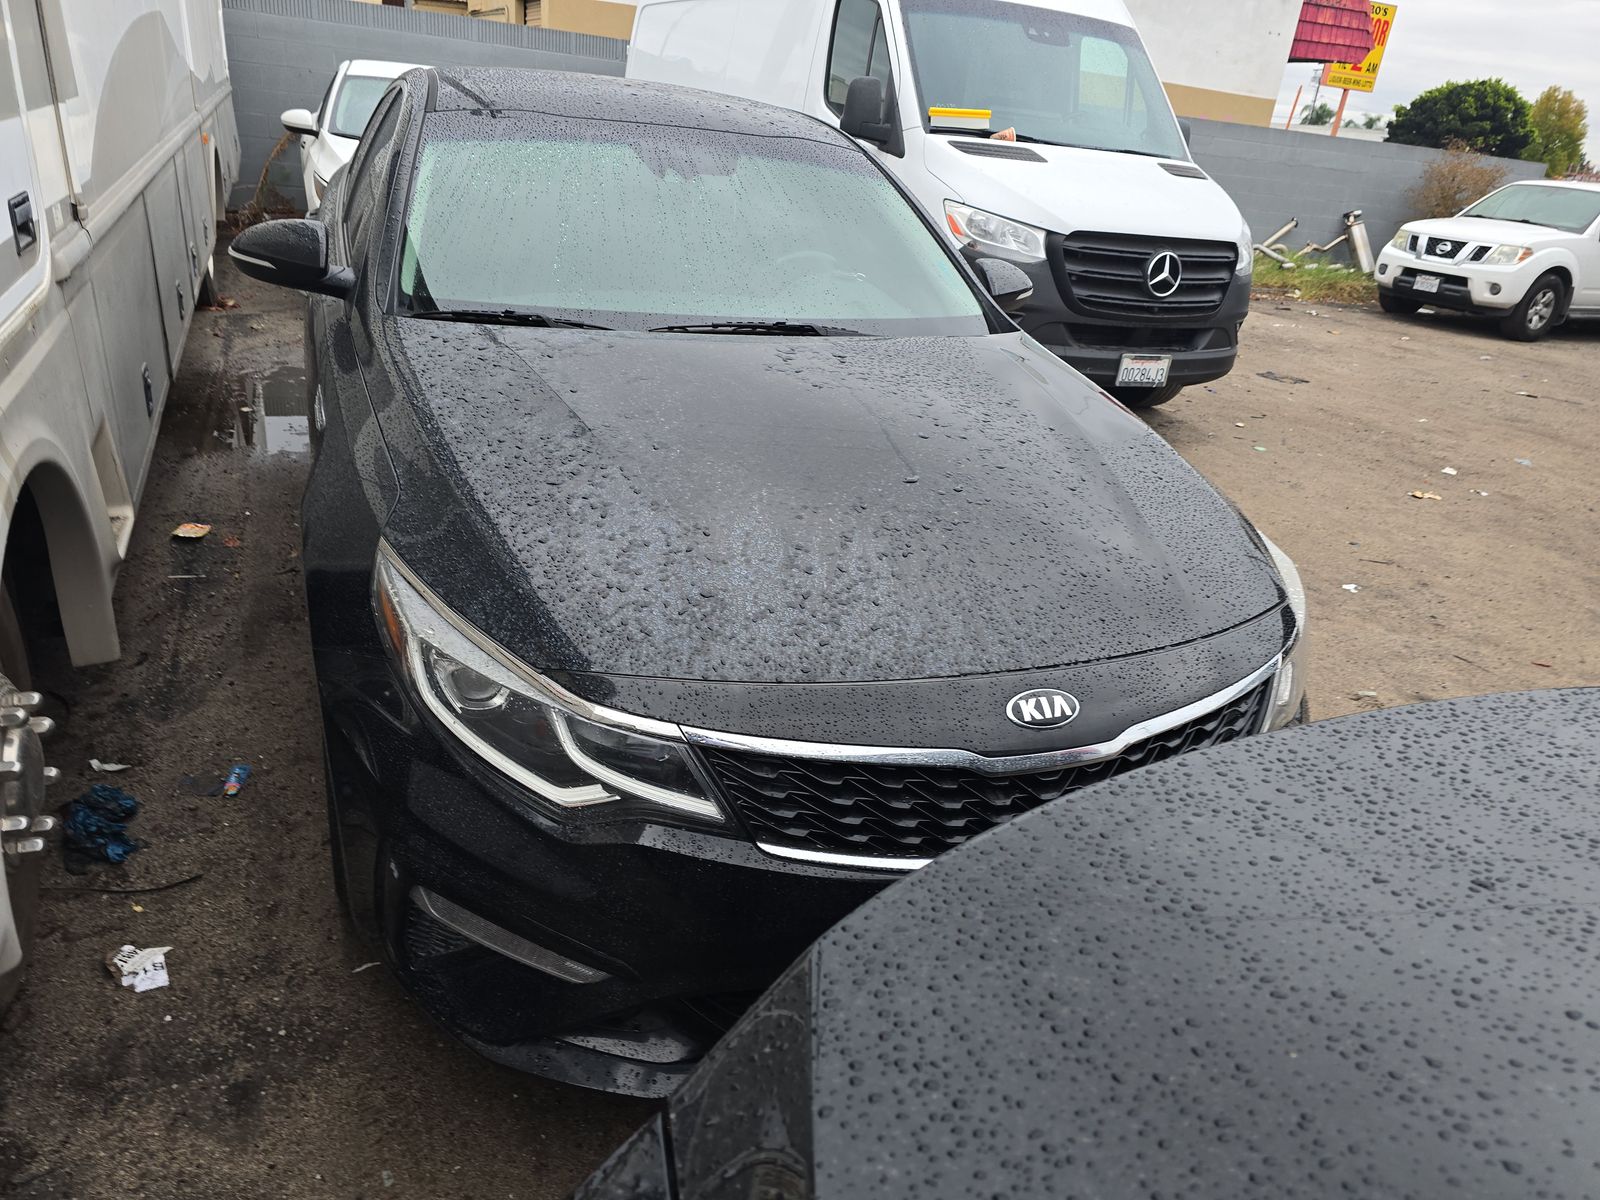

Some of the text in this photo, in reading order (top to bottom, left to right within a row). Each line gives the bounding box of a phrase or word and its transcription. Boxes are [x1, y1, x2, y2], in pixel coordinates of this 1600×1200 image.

[1366, 62, 1378, 74] AM
[1121, 367, 1165, 382] 00284J3
[1017, 695, 1073, 722] KIA
